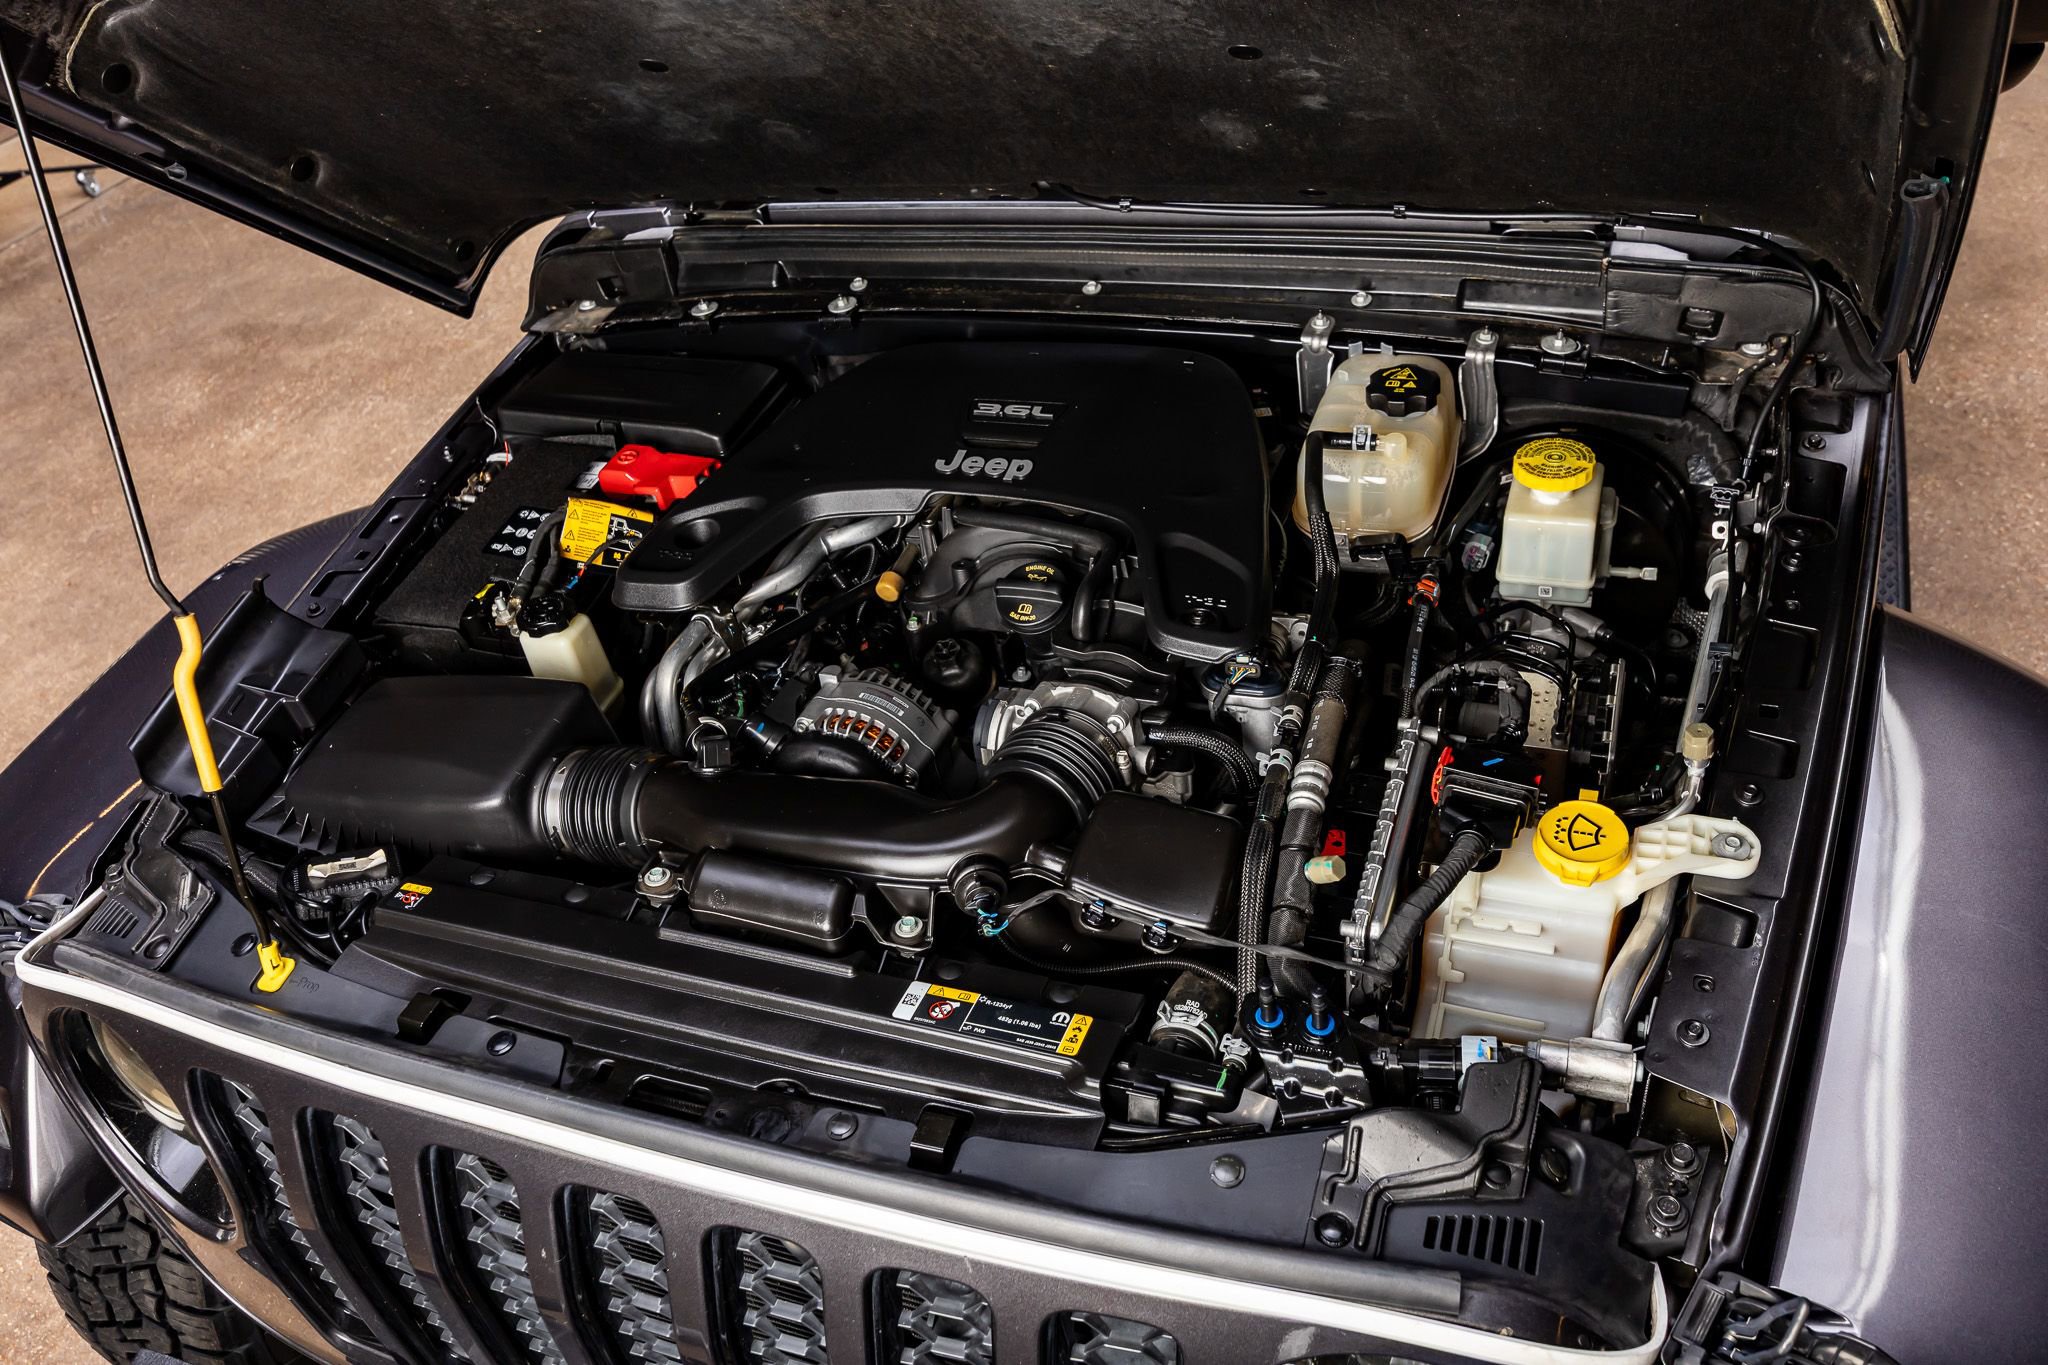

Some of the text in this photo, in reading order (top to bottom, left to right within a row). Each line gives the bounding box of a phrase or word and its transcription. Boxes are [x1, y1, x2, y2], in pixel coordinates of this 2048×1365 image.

[973, 402, 1053, 420] 3.6L
[934, 449, 1034, 483] Jeep
[1025, 564, 1055, 575] ENGINE OIL
[1009, 611, 1020, 620] SAE
[985, 999, 1013, 1009] R-1234yf
[1185, 999, 1200, 1008] RAD
